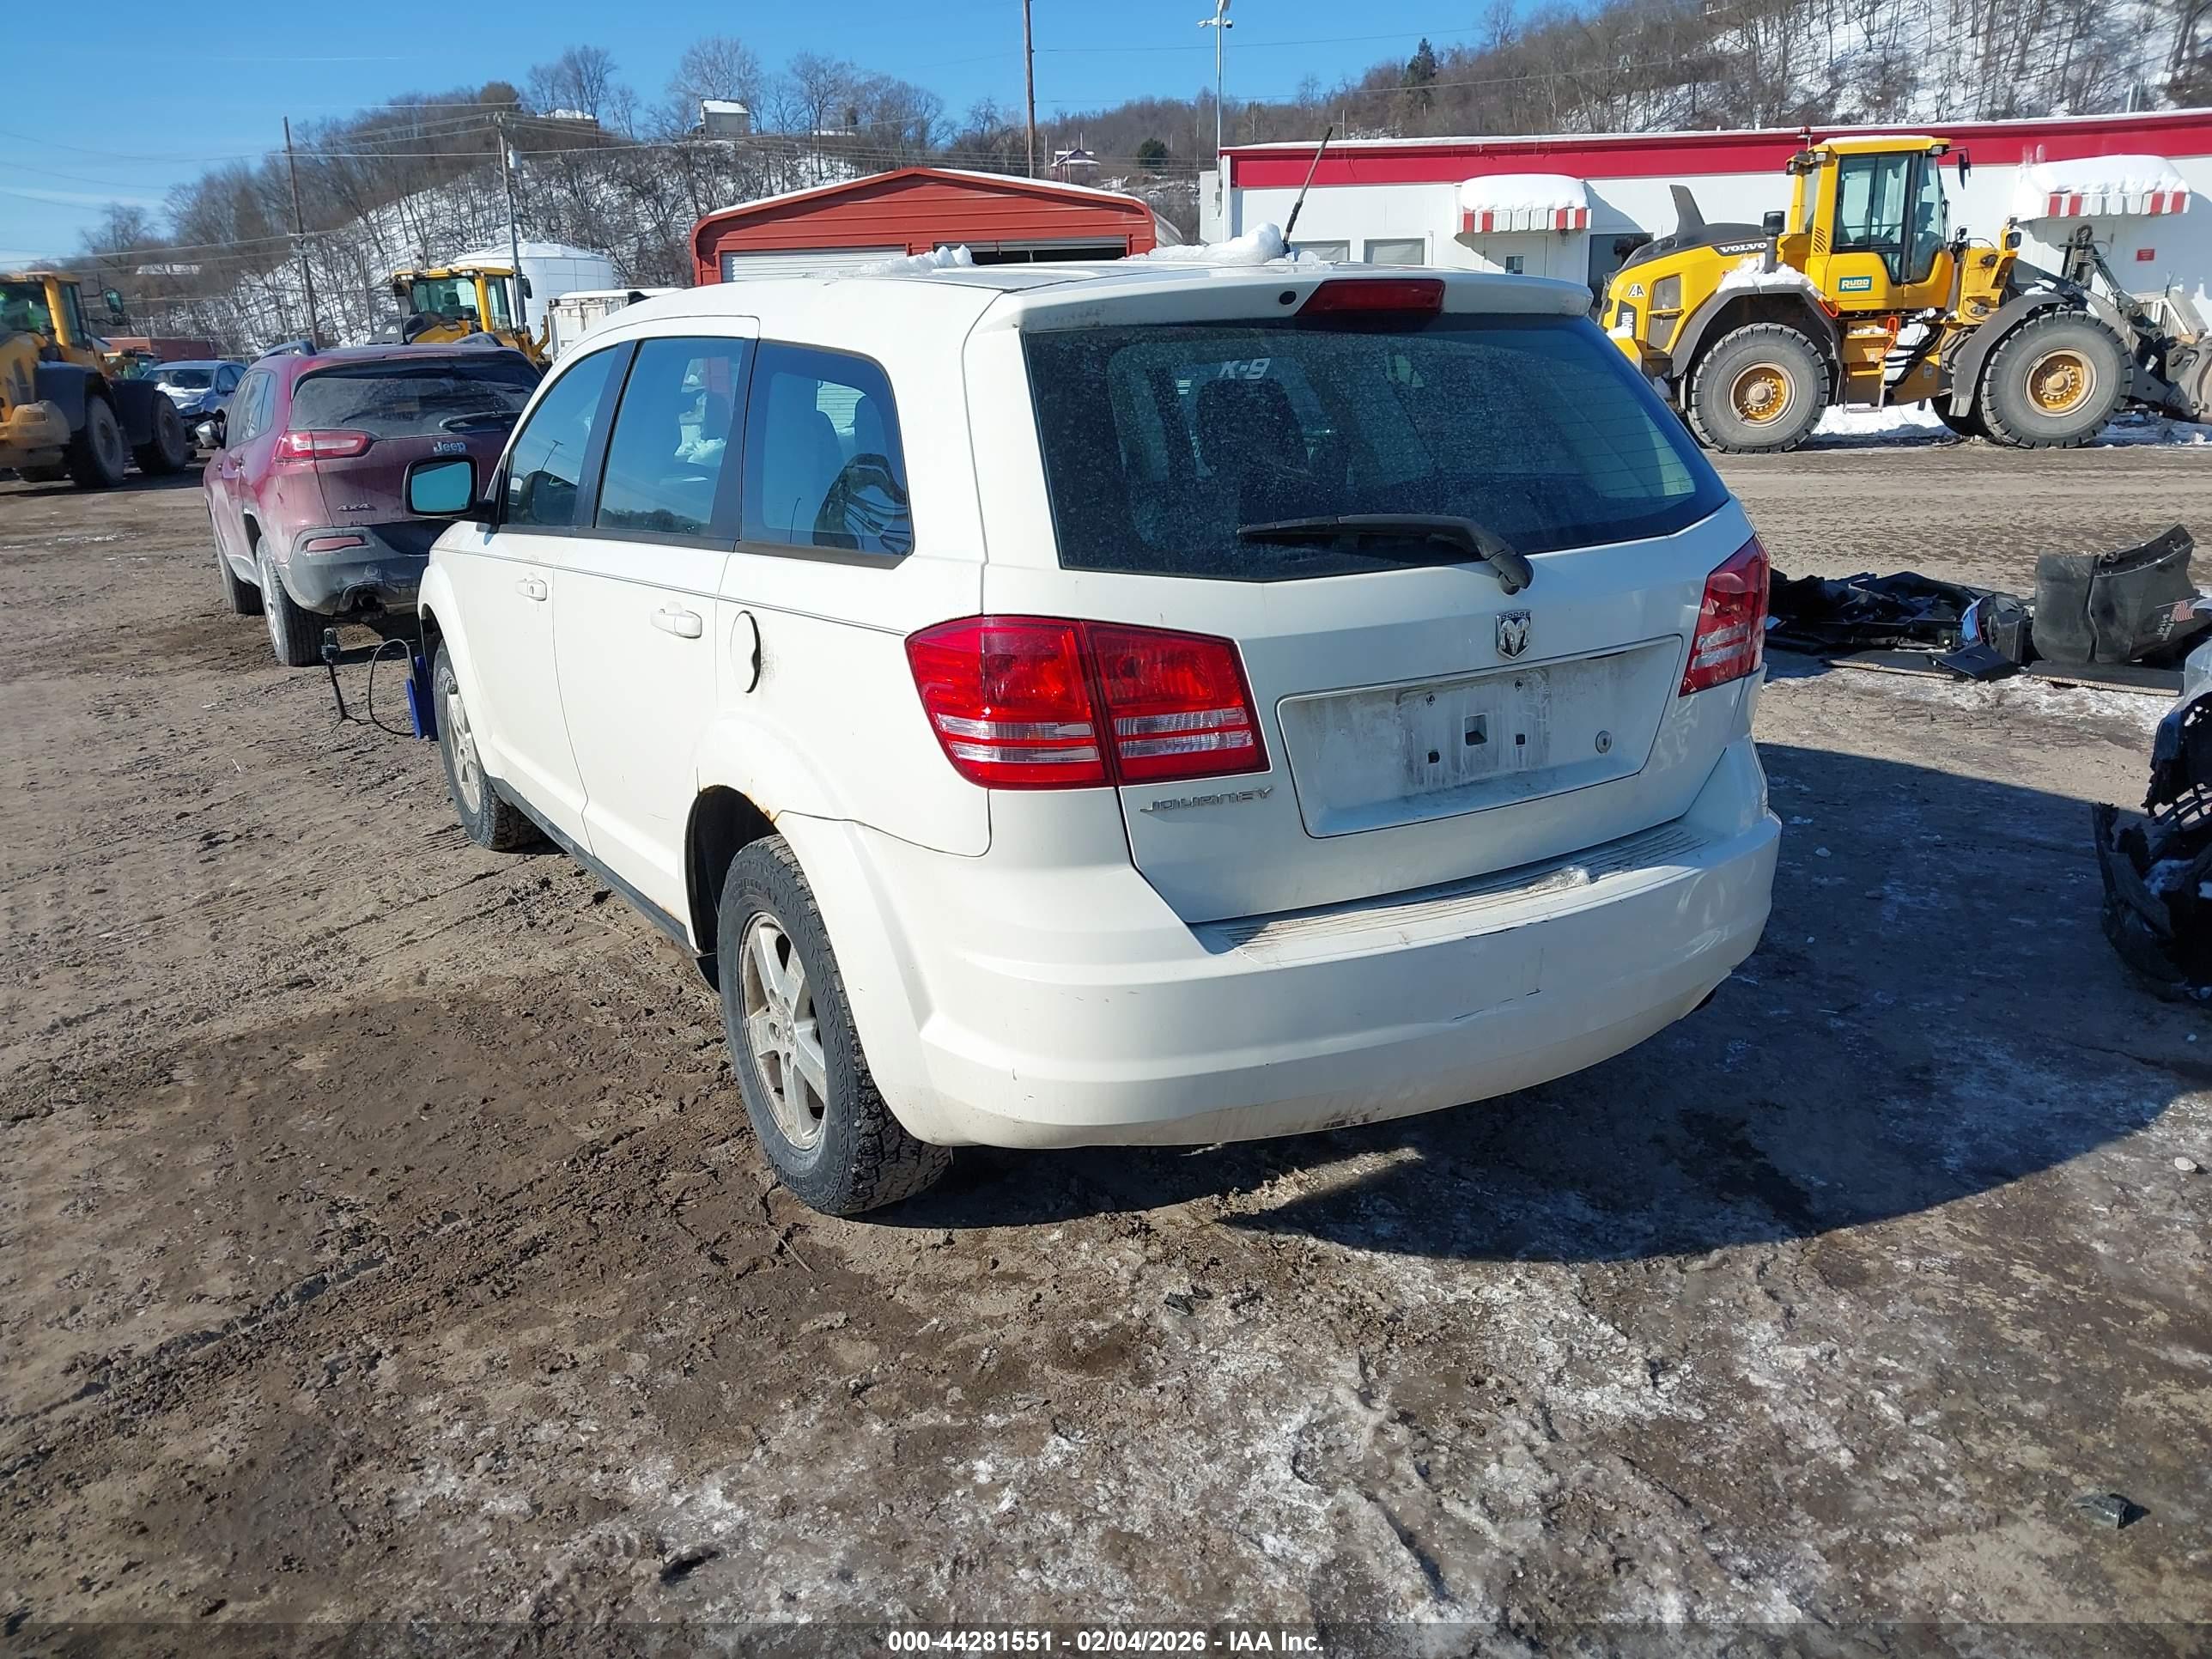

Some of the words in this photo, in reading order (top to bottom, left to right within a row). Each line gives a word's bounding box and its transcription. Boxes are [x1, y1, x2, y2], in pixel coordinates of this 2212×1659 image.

[1719, 242, 1767, 253] VOLVO
[1841, 279, 1869, 289] RUDD
[1218, 358, 1271, 379] K-9
[434, 441, 466, 453] Jeep
[1501, 611, 1531, 619] DODGE
[1140, 786, 1273, 812] JOURNEY
